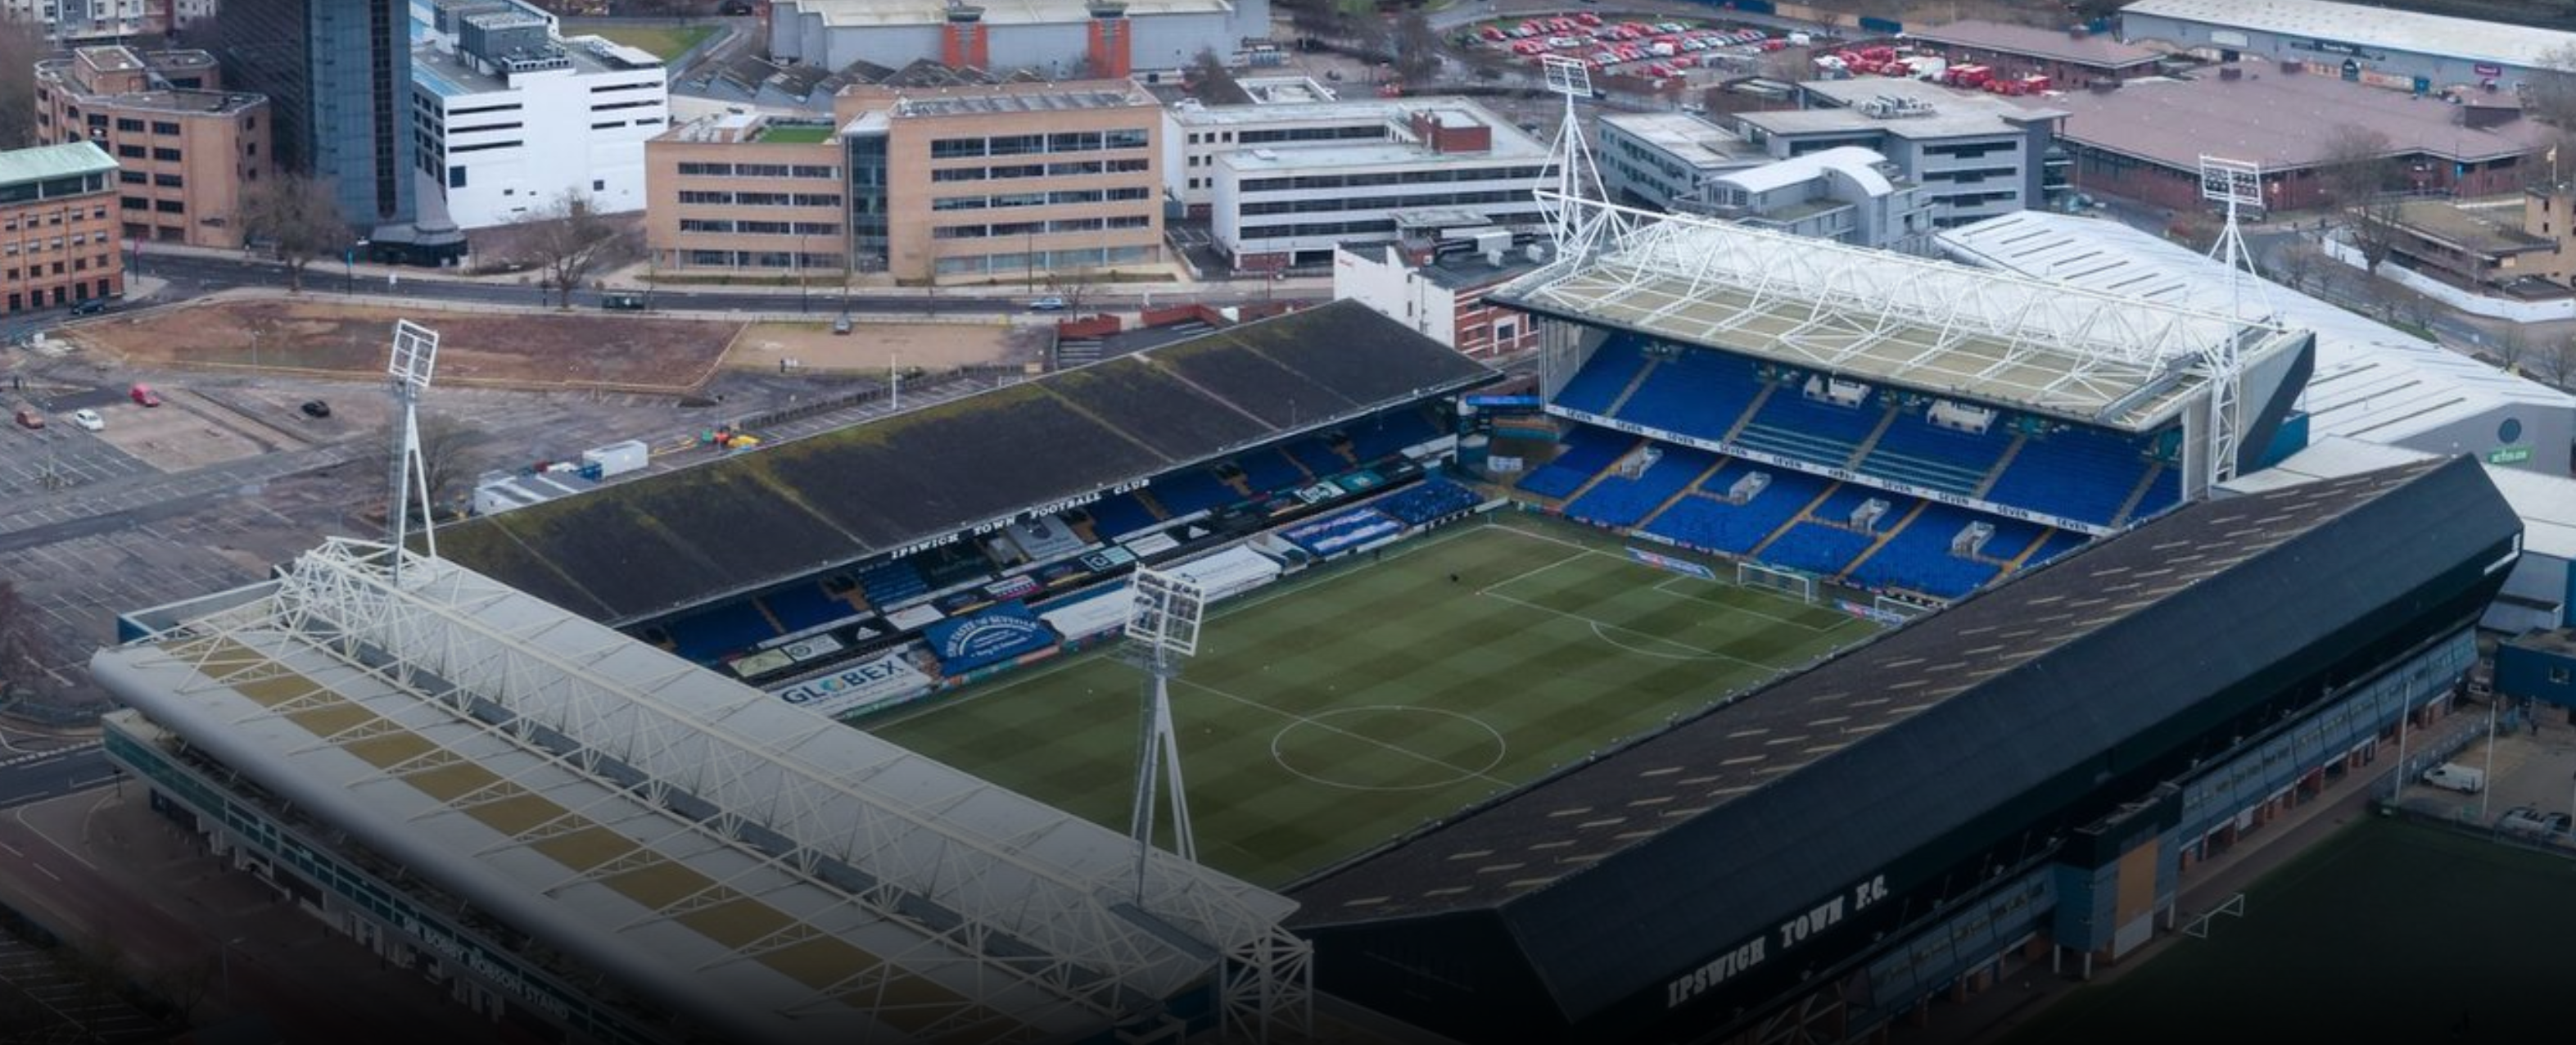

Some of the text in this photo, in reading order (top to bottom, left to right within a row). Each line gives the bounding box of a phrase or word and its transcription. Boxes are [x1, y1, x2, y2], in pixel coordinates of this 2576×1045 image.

[890, 478, 1151, 560] IPSWICH TOWN FOOTBALL CLUB
[1938, 491, 1970, 507] SEVEN
[1996, 504, 2029, 519] SEVEN
[781, 660, 904, 704] GLOBEX
[423, 927, 464, 963] BOBBY
[469, 951, 522, 995] ROBSON
[526, 984, 569, 1020] STAND
[1668, 874, 1888, 1009] IPSWICH TOWN F.C.
